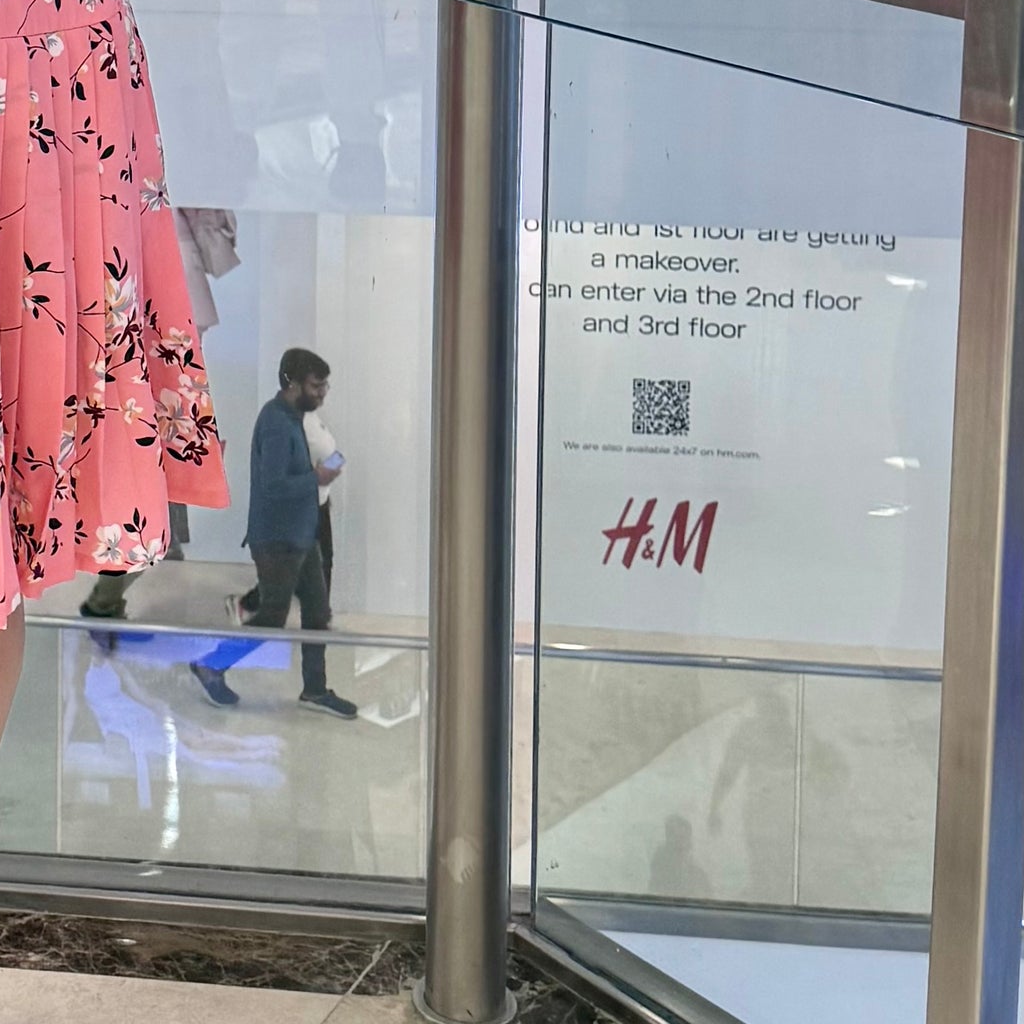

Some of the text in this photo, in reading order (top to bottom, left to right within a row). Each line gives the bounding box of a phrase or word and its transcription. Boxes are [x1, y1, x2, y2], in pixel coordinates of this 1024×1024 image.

[591, 250, 739, 274] a makeover.
[581, 282, 646, 302] enter
[653, 283, 687, 304] via
[696, 284, 737, 306] the
[746, 286, 794, 309] 2nd
[802, 289, 862, 311] floor
[582, 314, 747, 339] and 3rd floor
[562, 441, 579, 451] We
[582, 443, 599, 451] are
[601, 443, 623, 453] also
[625, 443, 670, 455] available
[700, 448, 714, 457] on
[601, 496, 718, 574] H&M
